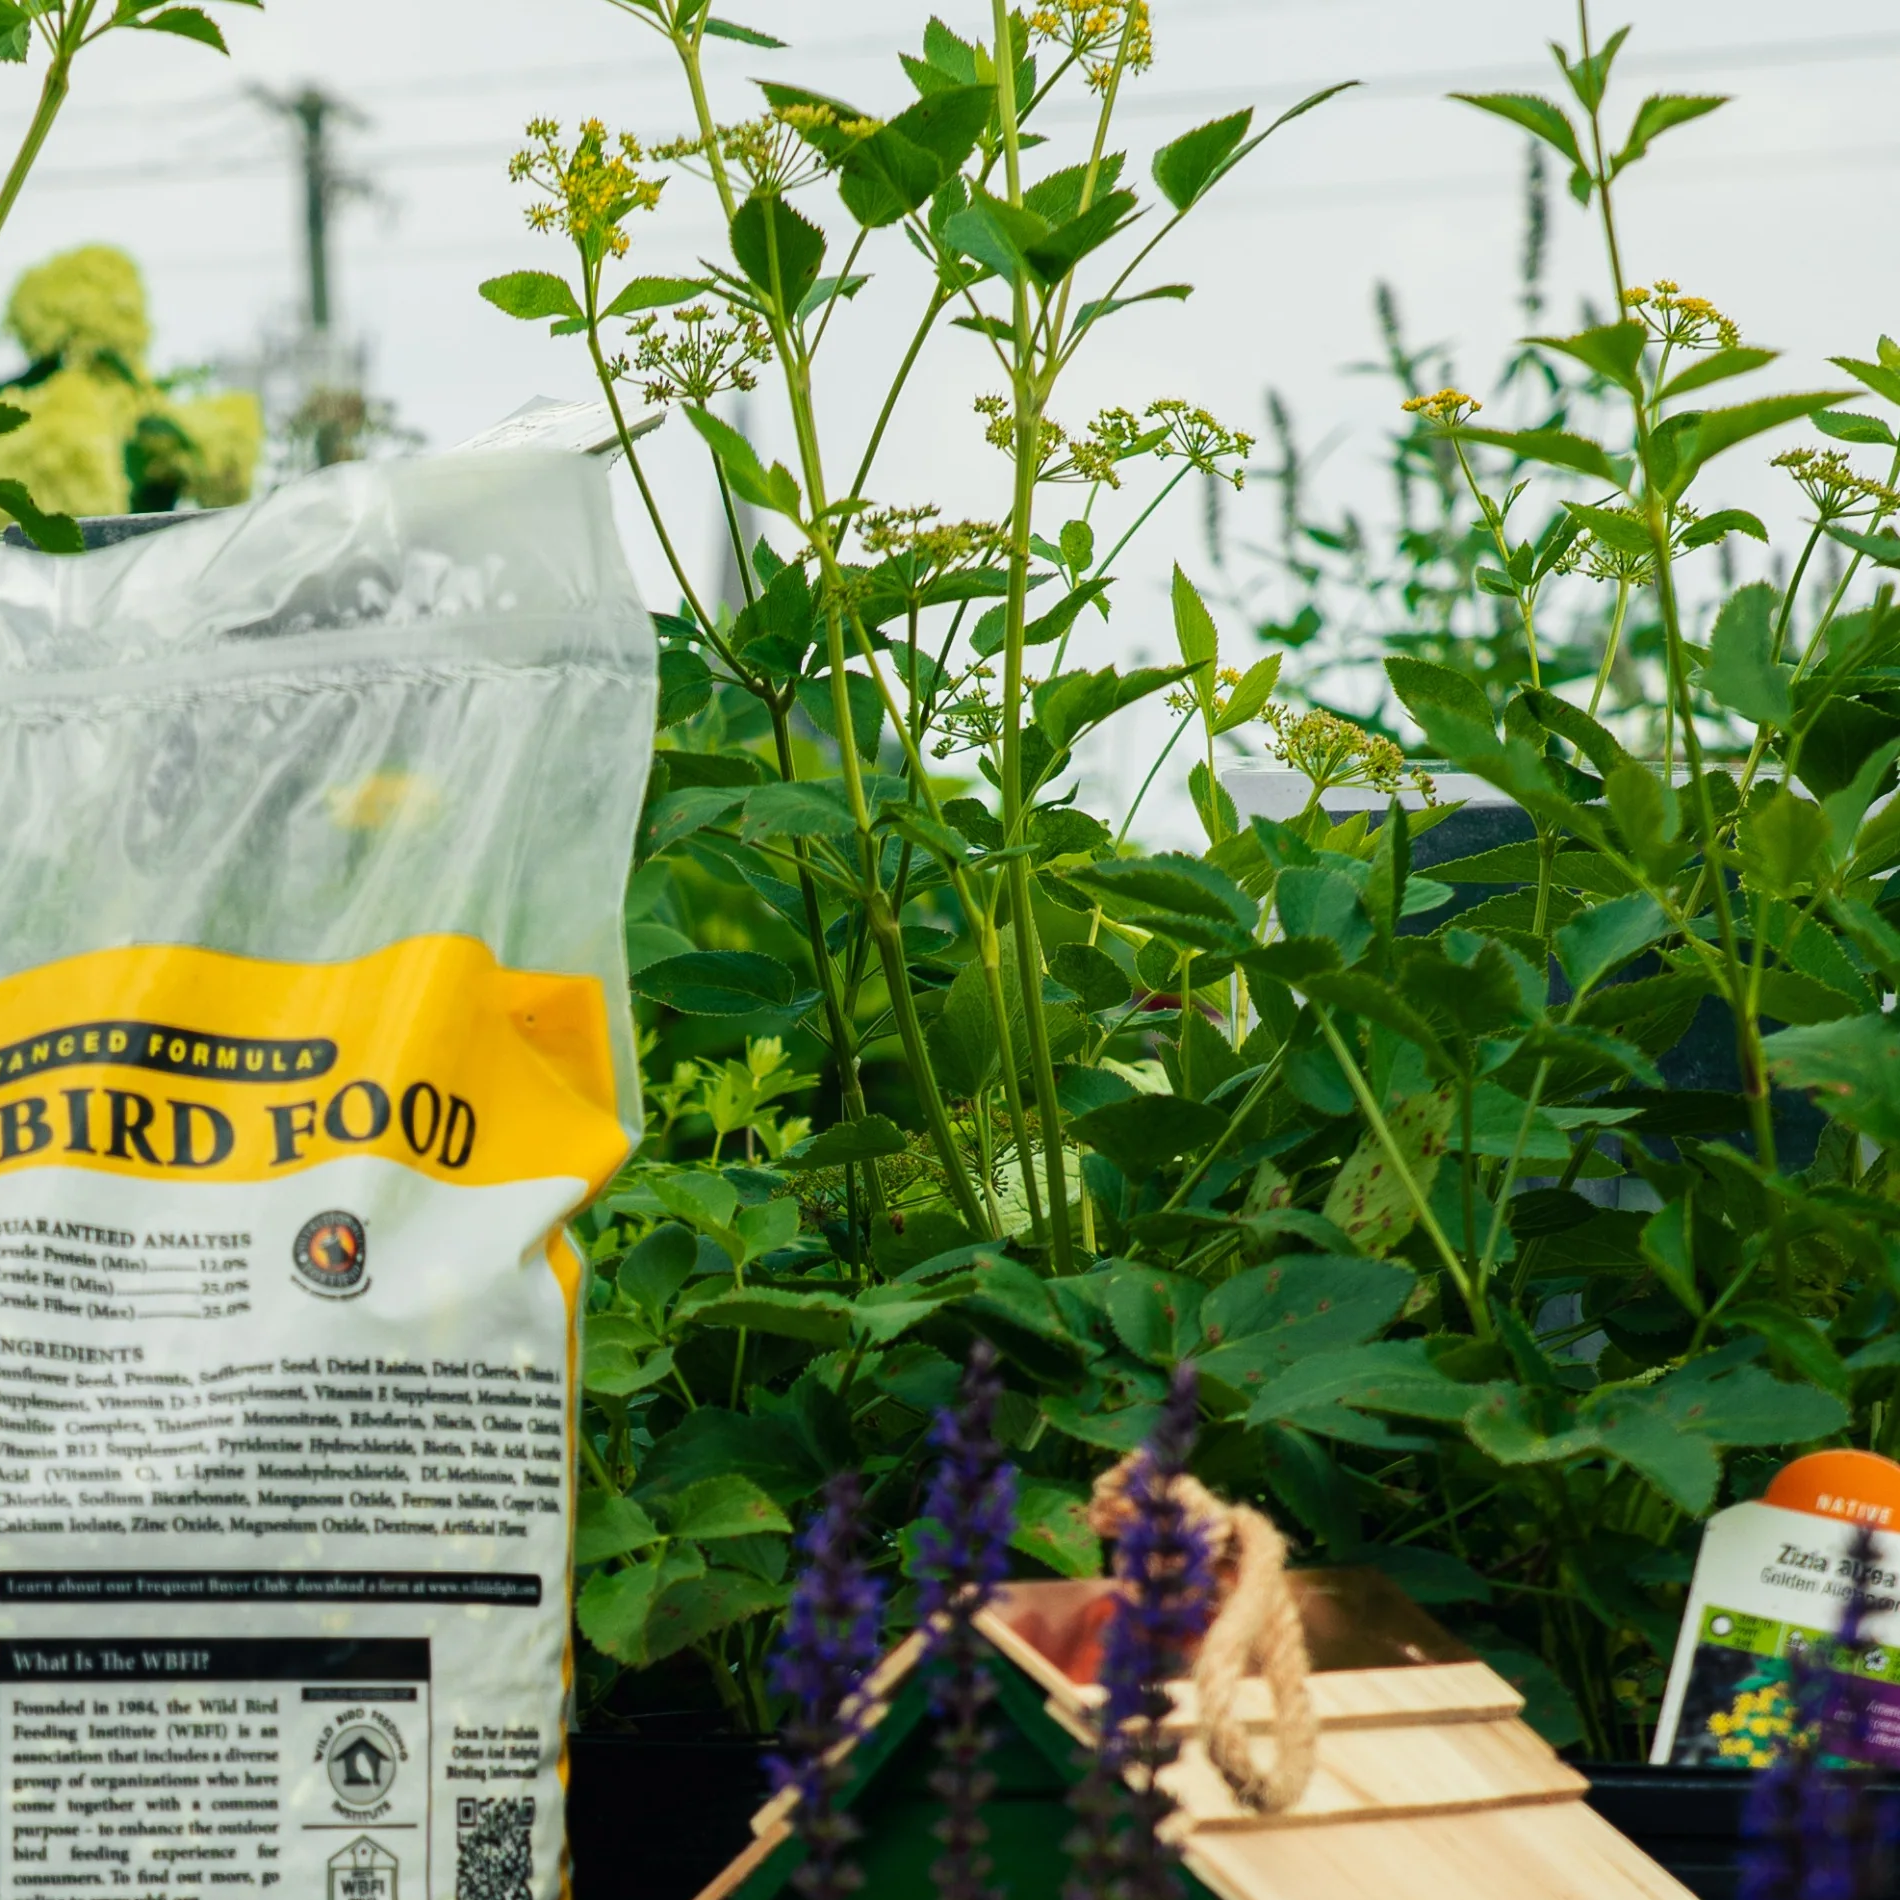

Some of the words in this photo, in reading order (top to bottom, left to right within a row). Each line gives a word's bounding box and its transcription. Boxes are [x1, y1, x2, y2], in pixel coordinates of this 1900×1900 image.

[149, 1034, 314, 1073] FORMULA
[270, 1080, 477, 1169] FOOD
[143, 1232, 252, 1249] ANALYSIS
[43, 1247, 97, 1268] Protein
[101, 1255, 147, 1274] (Min)
[70, 1277, 114, 1296] (Min)
[327, 1359, 370, 1375] Dried
[432, 1361, 468, 1378] Dried
[97, 1395, 164, 1410] Vitamin
[315, 1385, 372, 1400] Vitamin
[155, 1415, 233, 1434] Thiamine
[218, 1437, 302, 1455] Pyridoxine
[79, 1492, 143, 1506] Sodium
[1815, 1493, 1894, 1525] NATIVE
[131, 1517, 167, 1532] Zinc
[172, 1516, 225, 1535] Oxide,
[230, 1517, 317, 1537] Magnesium
[321, 1517, 370, 1535] Oxide,
[1778, 1543, 1828, 1574] Zizia
[7, 1578, 52, 1593] Learn
[57, 1578, 101, 1593] about
[137, 1577, 203, 1596] Frequent
[207, 1578, 250, 1596] Buyer
[296, 1578, 365, 1593] download
[1760, 1566, 1816, 1592] Golden
[12, 1651, 68, 1672] What
[74, 1652, 93, 1671] Is
[100, 1652, 136, 1671] The
[141, 1651, 210, 1671] WBFI?
[13, 1700, 85, 1716] Founded
[93, 1700, 108, 1715] in
[117, 1700, 159, 1717] 1984,
[167, 1699, 192, 1715] the
[200, 1698, 237, 1714] Wild
[245, 1698, 278, 1714] Bird
[13, 1725, 77, 1742] Feeding
[88, 1724, 157, 1739] Institute
[167, 1723, 228, 1741] (WBFI)
[238, 1723, 251, 1738] is
[13, 1749, 103, 1764] association
[108, 1749, 138, 1763] that
[143, 1748, 209, 1763] includes
[225, 1748, 278, 1763] diverse
[13, 1776, 62, 1792] group
[68, 1773, 85, 1788] of
[91, 1774, 200, 1791] organizations
[206, 1772, 239, 1787] who
[245, 1772, 279, 1787] have
[13, 1801, 55, 1813] come
[68, 1799, 134, 1817] together
[146, 1797, 181, 1811] with
[211, 1799, 279, 1810] common
[13, 1825, 80, 1841] purpose
[98, 1823, 113, 1836] to
[118, 1822, 184, 1836] enhance
[189, 1821, 213, 1835] the
[218, 1821, 279, 1835] outdoor
[13, 1847, 47, 1862] bird
[70, 1847, 130, 1864] feeding
[152, 1846, 237, 1863] experience
[258, 1844, 279, 1859] for
[111, 1871, 130, 1885] To
[137, 1870, 168, 1885] find
[176, 1871, 202, 1884] out
[262, 1872, 280, 1887] go
[341, 1879, 385, 1896] WBFI
